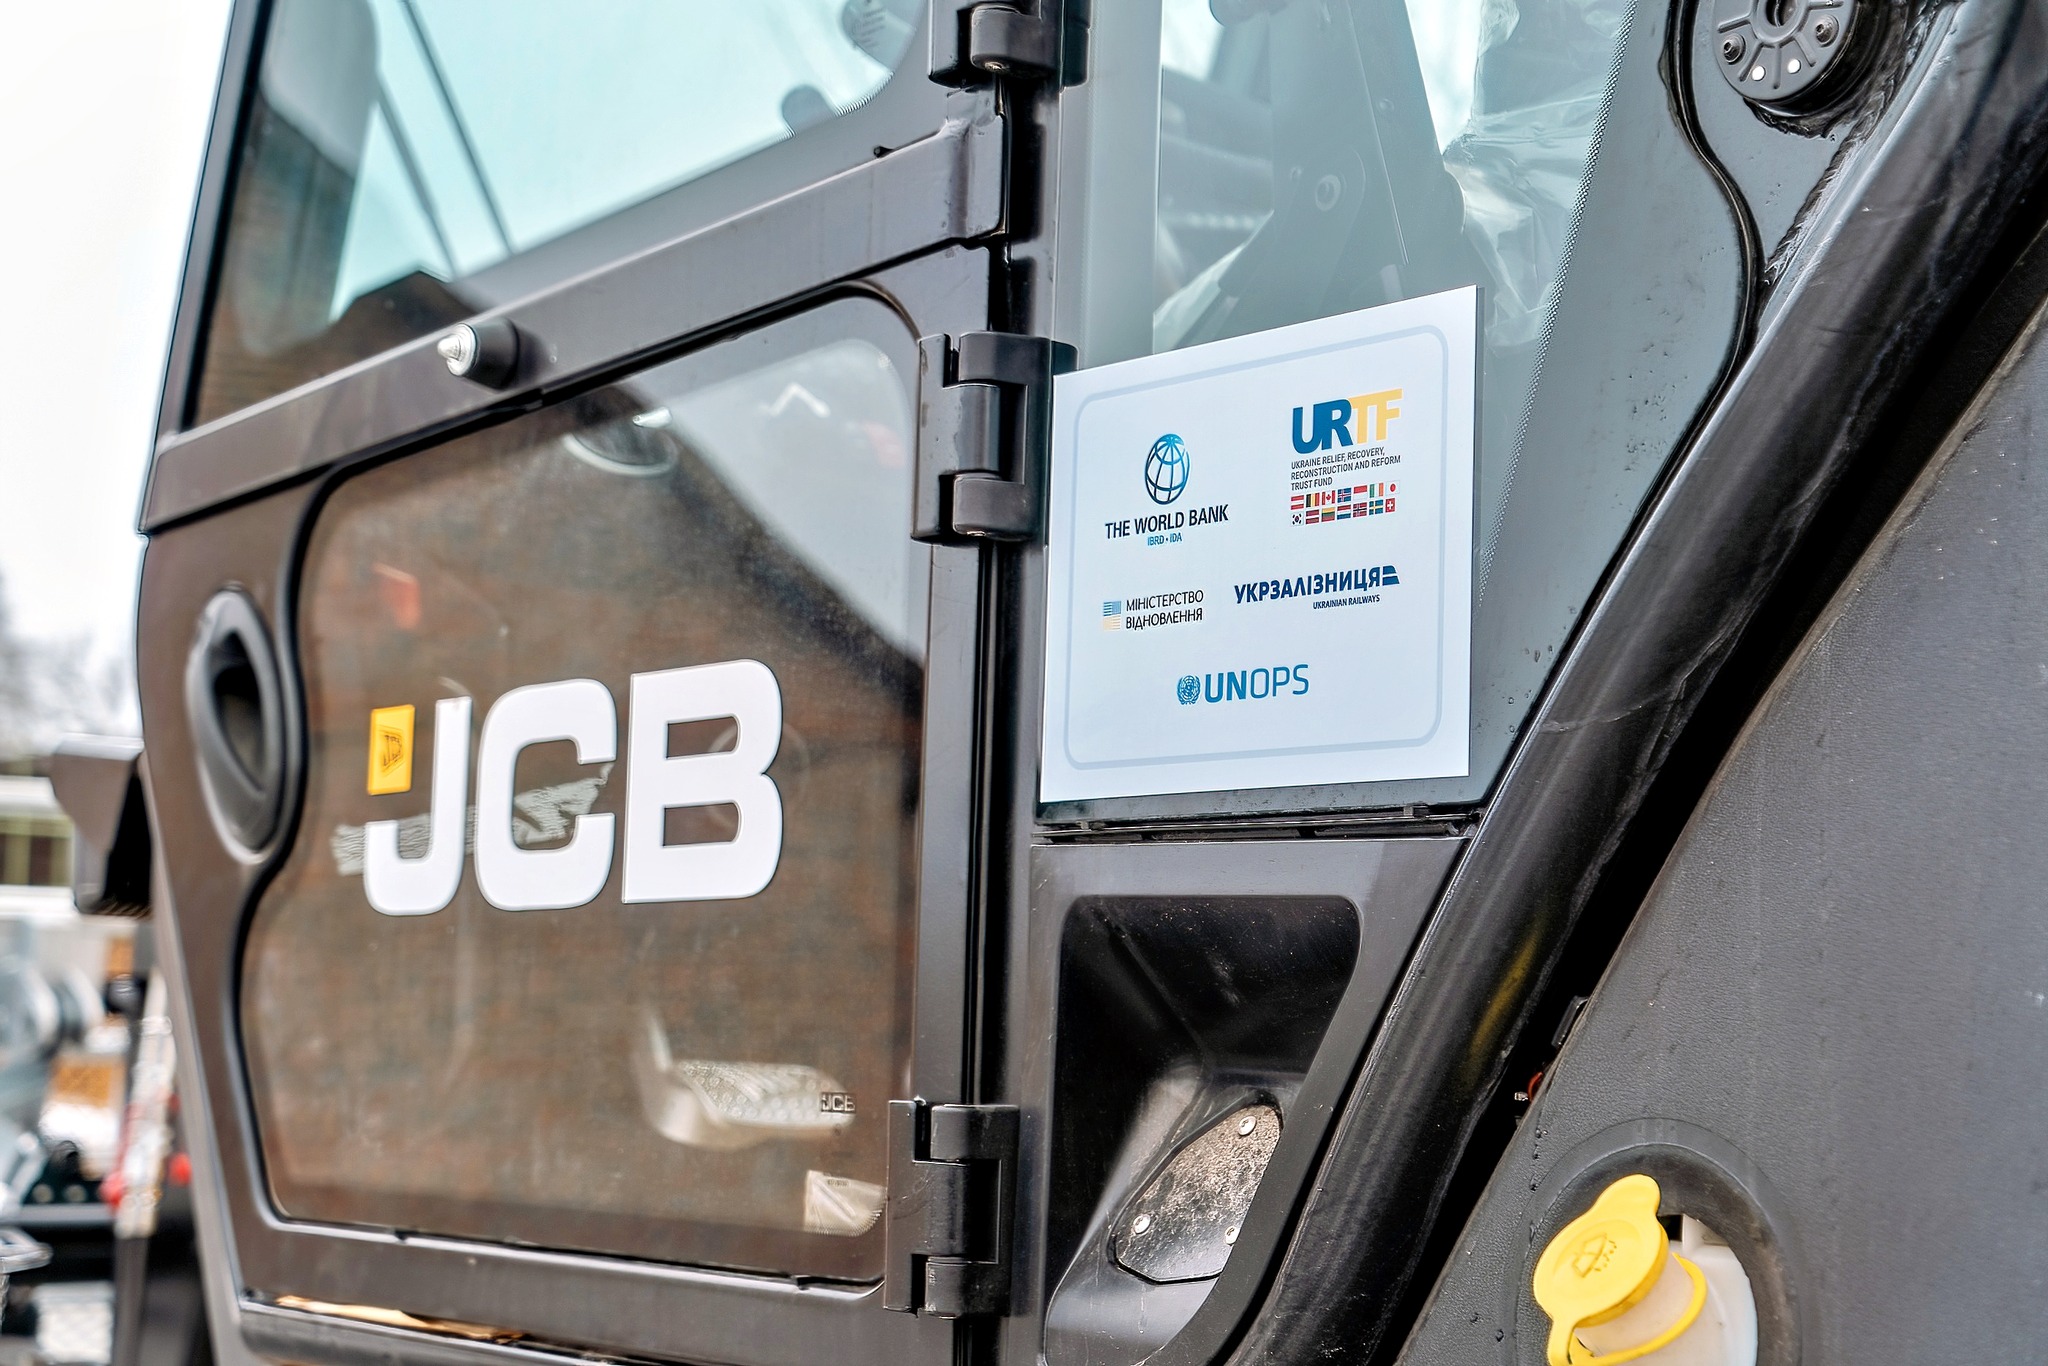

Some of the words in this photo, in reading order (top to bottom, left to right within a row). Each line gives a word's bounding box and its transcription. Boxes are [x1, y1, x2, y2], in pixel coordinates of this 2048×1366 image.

[1291, 388, 1403, 455] URTF
[1290, 463, 1354, 481] RECONSTRUCTION
[1354, 459, 1370, 470] AND
[1371, 455, 1401, 468] REFORM
[1291, 456, 1321, 470] UKRAINE
[1322, 453, 1346, 465] RELIEF,
[1347, 446, 1386, 460] RECOVERY,
[1290, 481, 1313, 492] TRUST
[1313, 476, 1333, 488] FUND
[1104, 519, 1131, 540] THE
[1134, 511, 1185, 535] WORLD
[1188, 504, 1229, 527] BANK
[1147, 535, 1165, 546] IBRD
[1169, 532, 1183, 543] IDA
[1234, 566, 1381, 605] УКРЗАЛІЗНИЦЯ
[1126, 589, 1204, 612] МІНІСТЕРСТВО
[1312, 599, 1348, 610] UKRAINIAN
[1348, 594, 1381, 606] RAILWAYS
[1125, 607, 1203, 631] ВІДНОВЛЕННЯ
[1204, 663, 1310, 704] UNOPS
[363, 658, 783, 917] JCB
[821, 1092, 856, 1113] JCB
